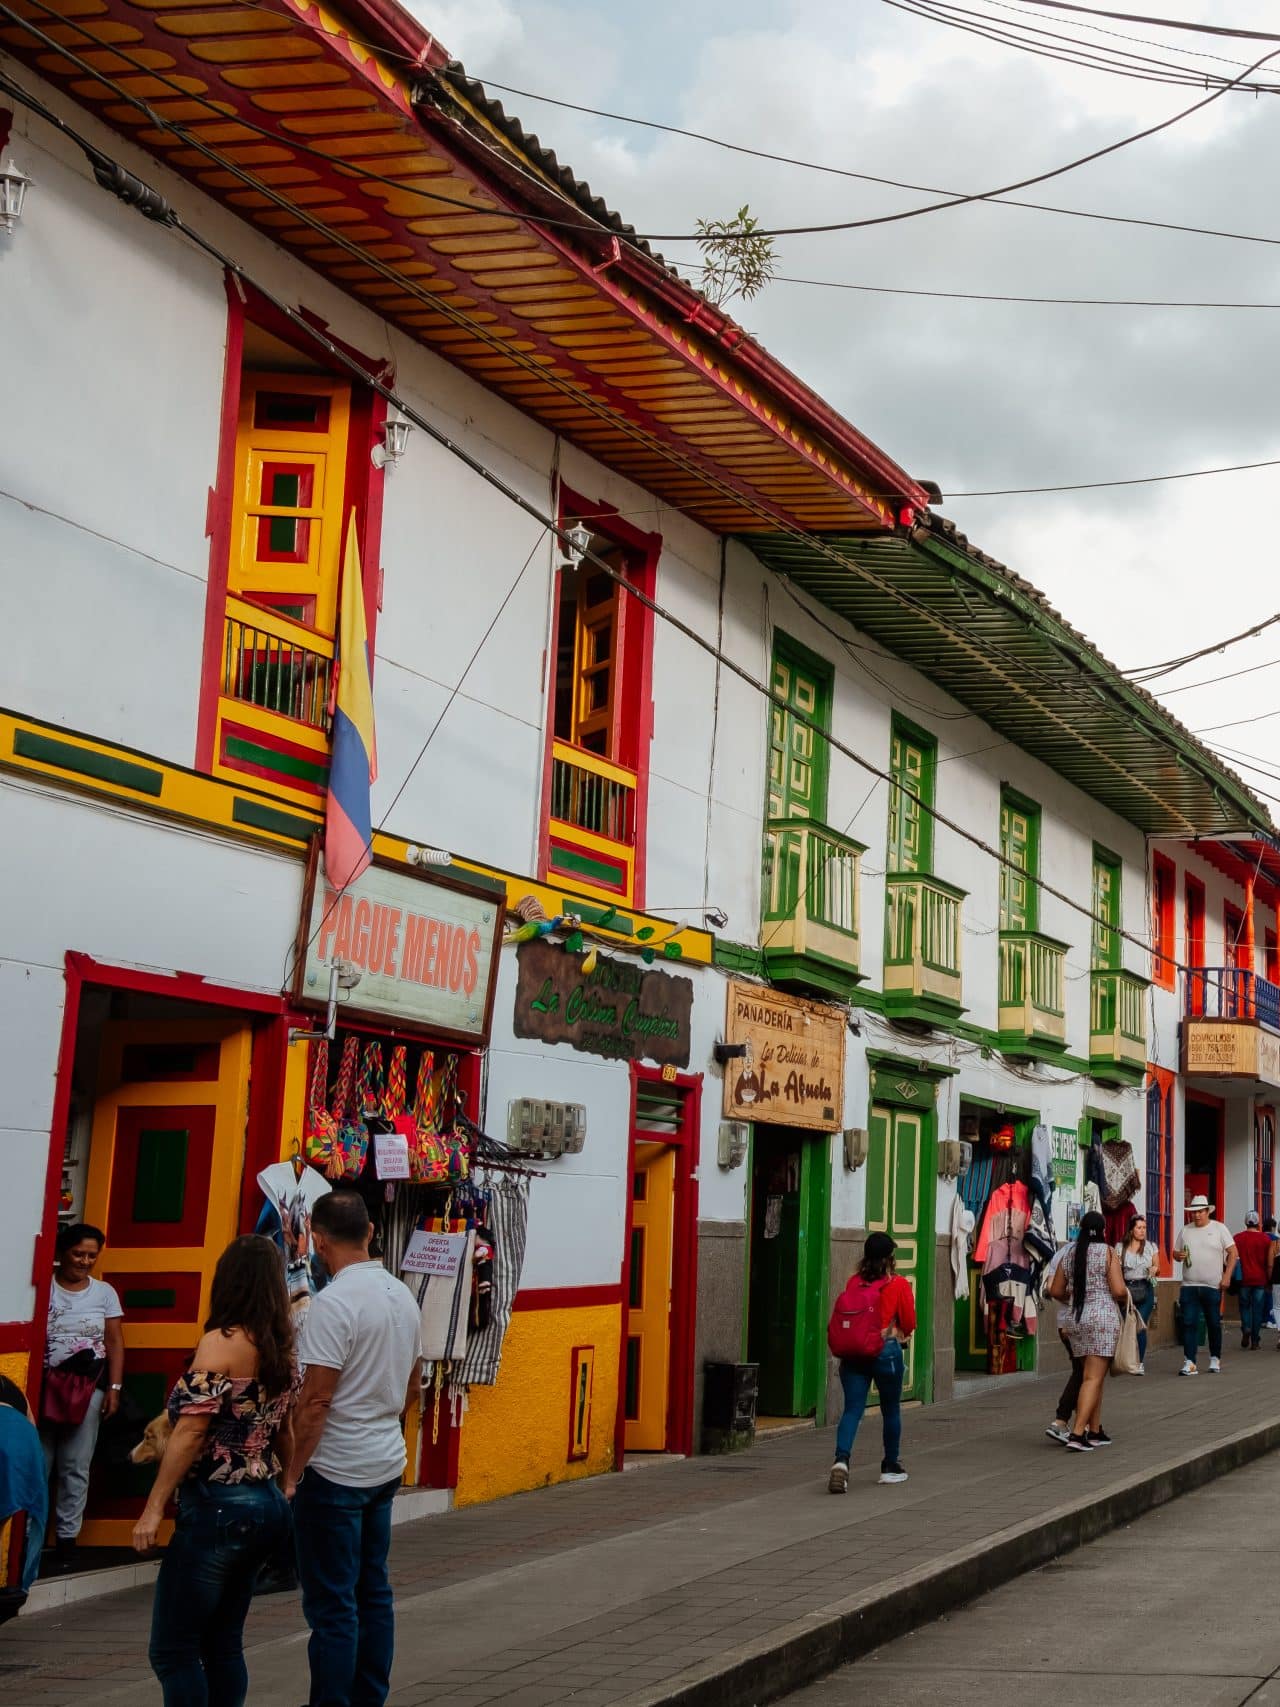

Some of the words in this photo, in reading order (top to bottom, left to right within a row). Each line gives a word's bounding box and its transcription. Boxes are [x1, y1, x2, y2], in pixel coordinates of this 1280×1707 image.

[317, 889, 403, 978] PAGUE
[531, 977, 560, 1014] La
[737, 1003, 793, 1032] PANADERÍA
[761, 1041, 774, 1062] Las
[776, 1043, 808, 1066] Delicias
[810, 1050, 820, 1068] de
[757, 1062, 780, 1104] La
[783, 1070, 833, 1105] Abuela
[422, 1245, 450, 1255] HAMACAS
[428, 1237, 449, 1246] OFERTA
[404, 1260, 436, 1269] POLIESTER
[409, 1252, 437, 1260] ALGODON
